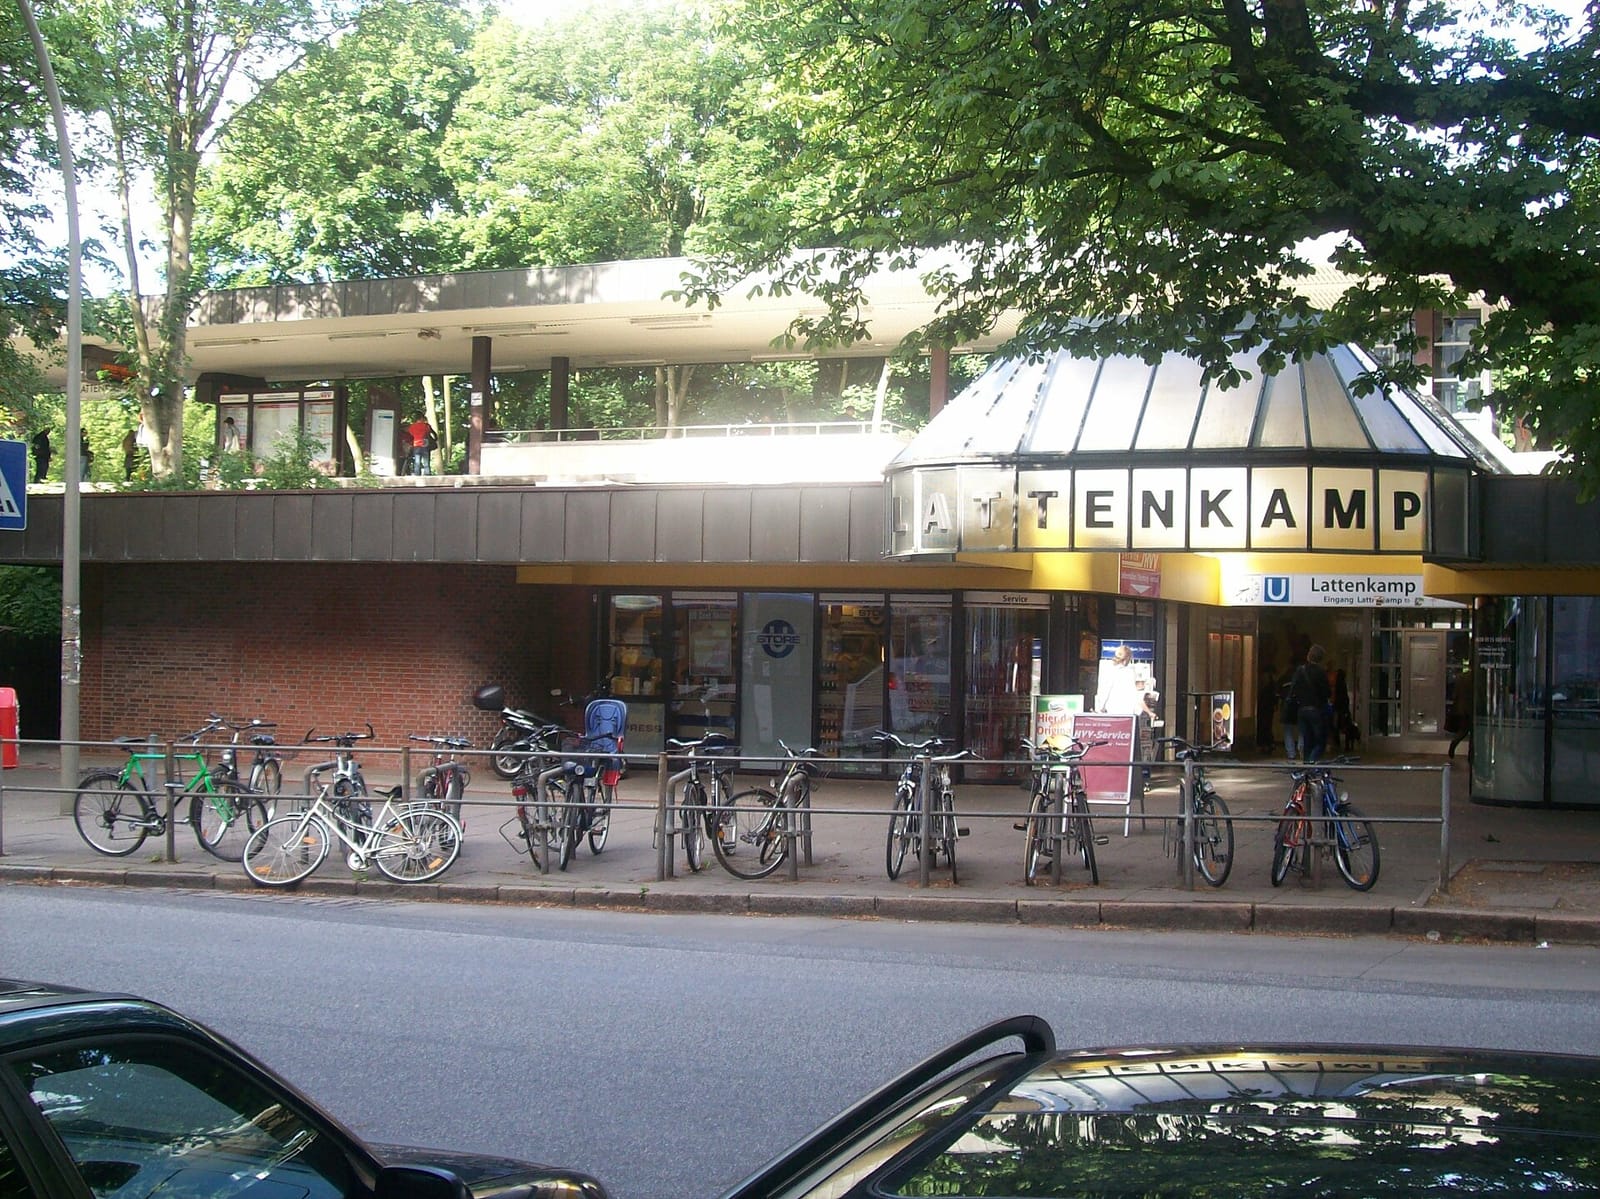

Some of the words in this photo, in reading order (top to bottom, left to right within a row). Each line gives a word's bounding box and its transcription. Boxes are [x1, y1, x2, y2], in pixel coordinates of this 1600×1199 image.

[893, 488, 1421, 535] LATTENKAMP
[1268, 578, 1287, 601] U
[1311, 577, 1416, 596] Lattenkamp
[1002, 594, 1028, 603] Service
[1323, 596, 1354, 604] Eingang
[757, 634, 800, 644] STORE
[1037, 713, 1057, 723] Hier
